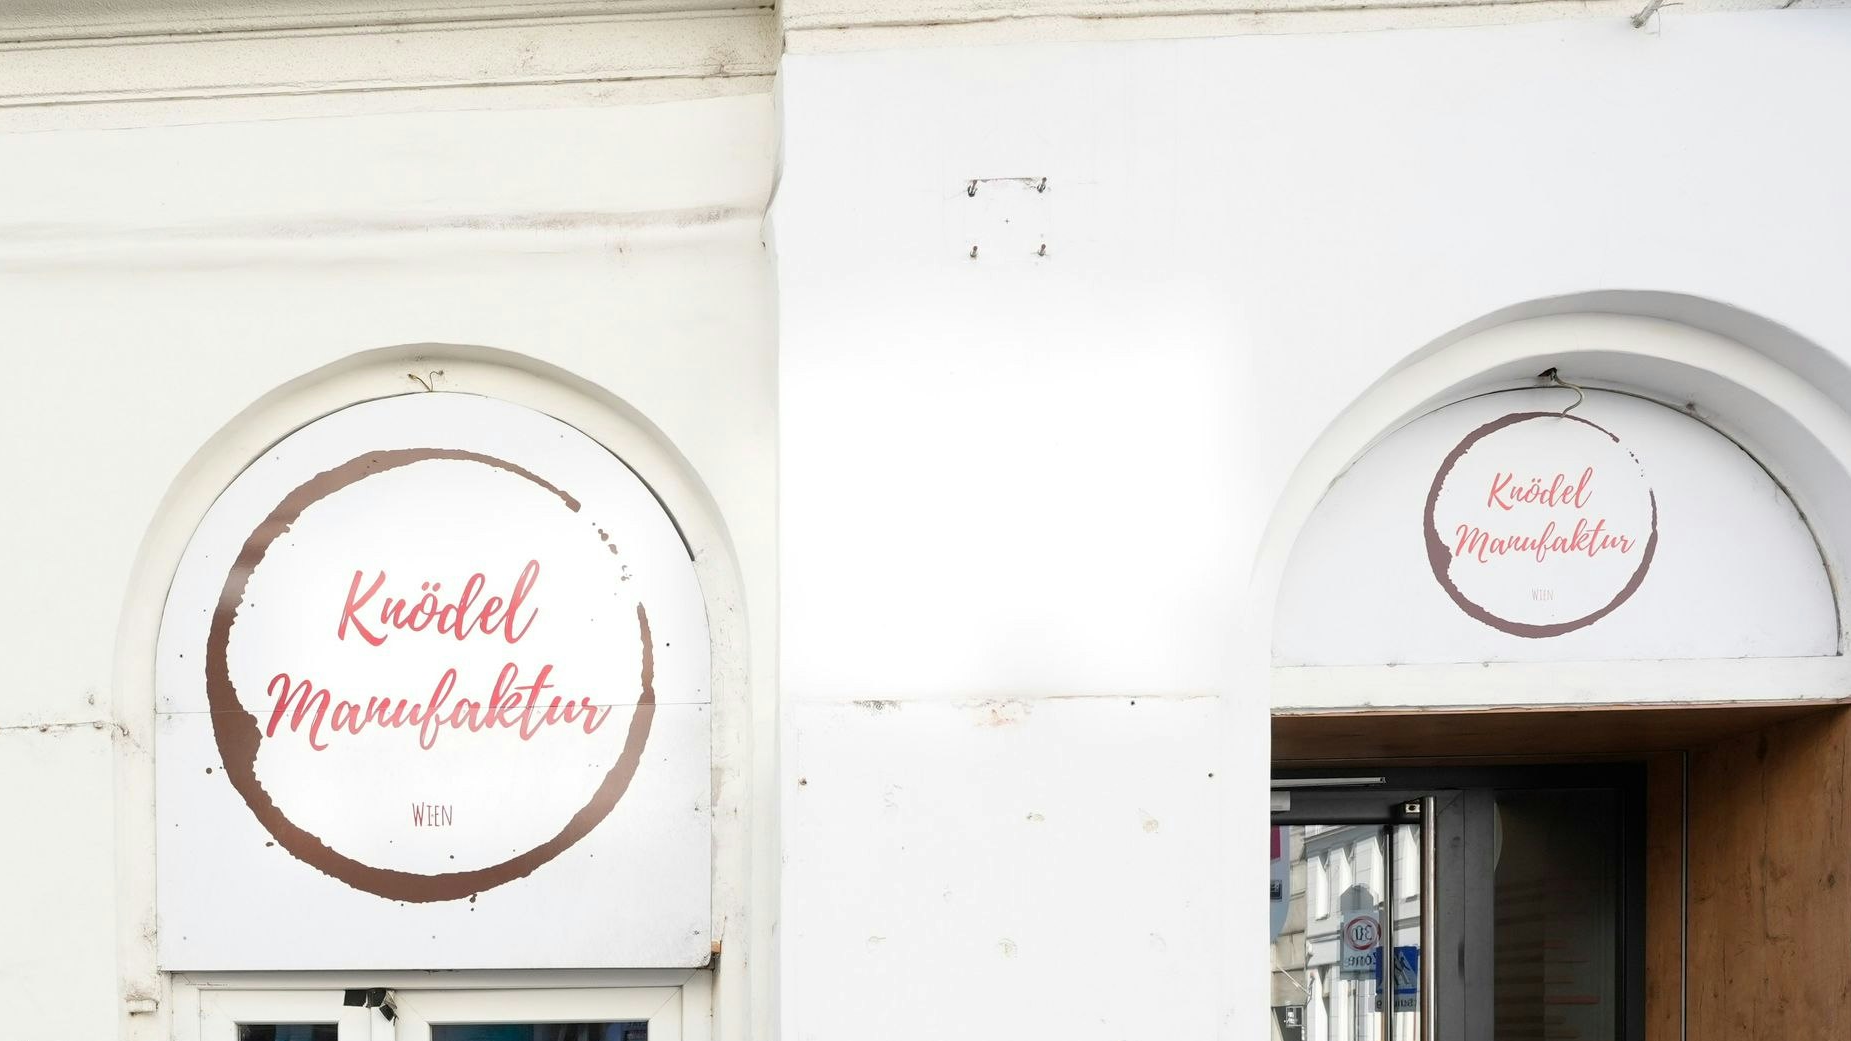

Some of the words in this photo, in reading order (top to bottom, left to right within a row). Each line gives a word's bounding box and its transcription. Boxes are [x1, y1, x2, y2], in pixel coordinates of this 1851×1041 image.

[1487, 466, 1594, 511] Knödel
[1454, 518, 1636, 563] Manufaktur
[337, 559, 541, 647] Knödel
[1531, 588, 1555, 602] WIEN
[266, 662, 613, 752] Manufaktur
[411, 801, 454, 828] WIEN
